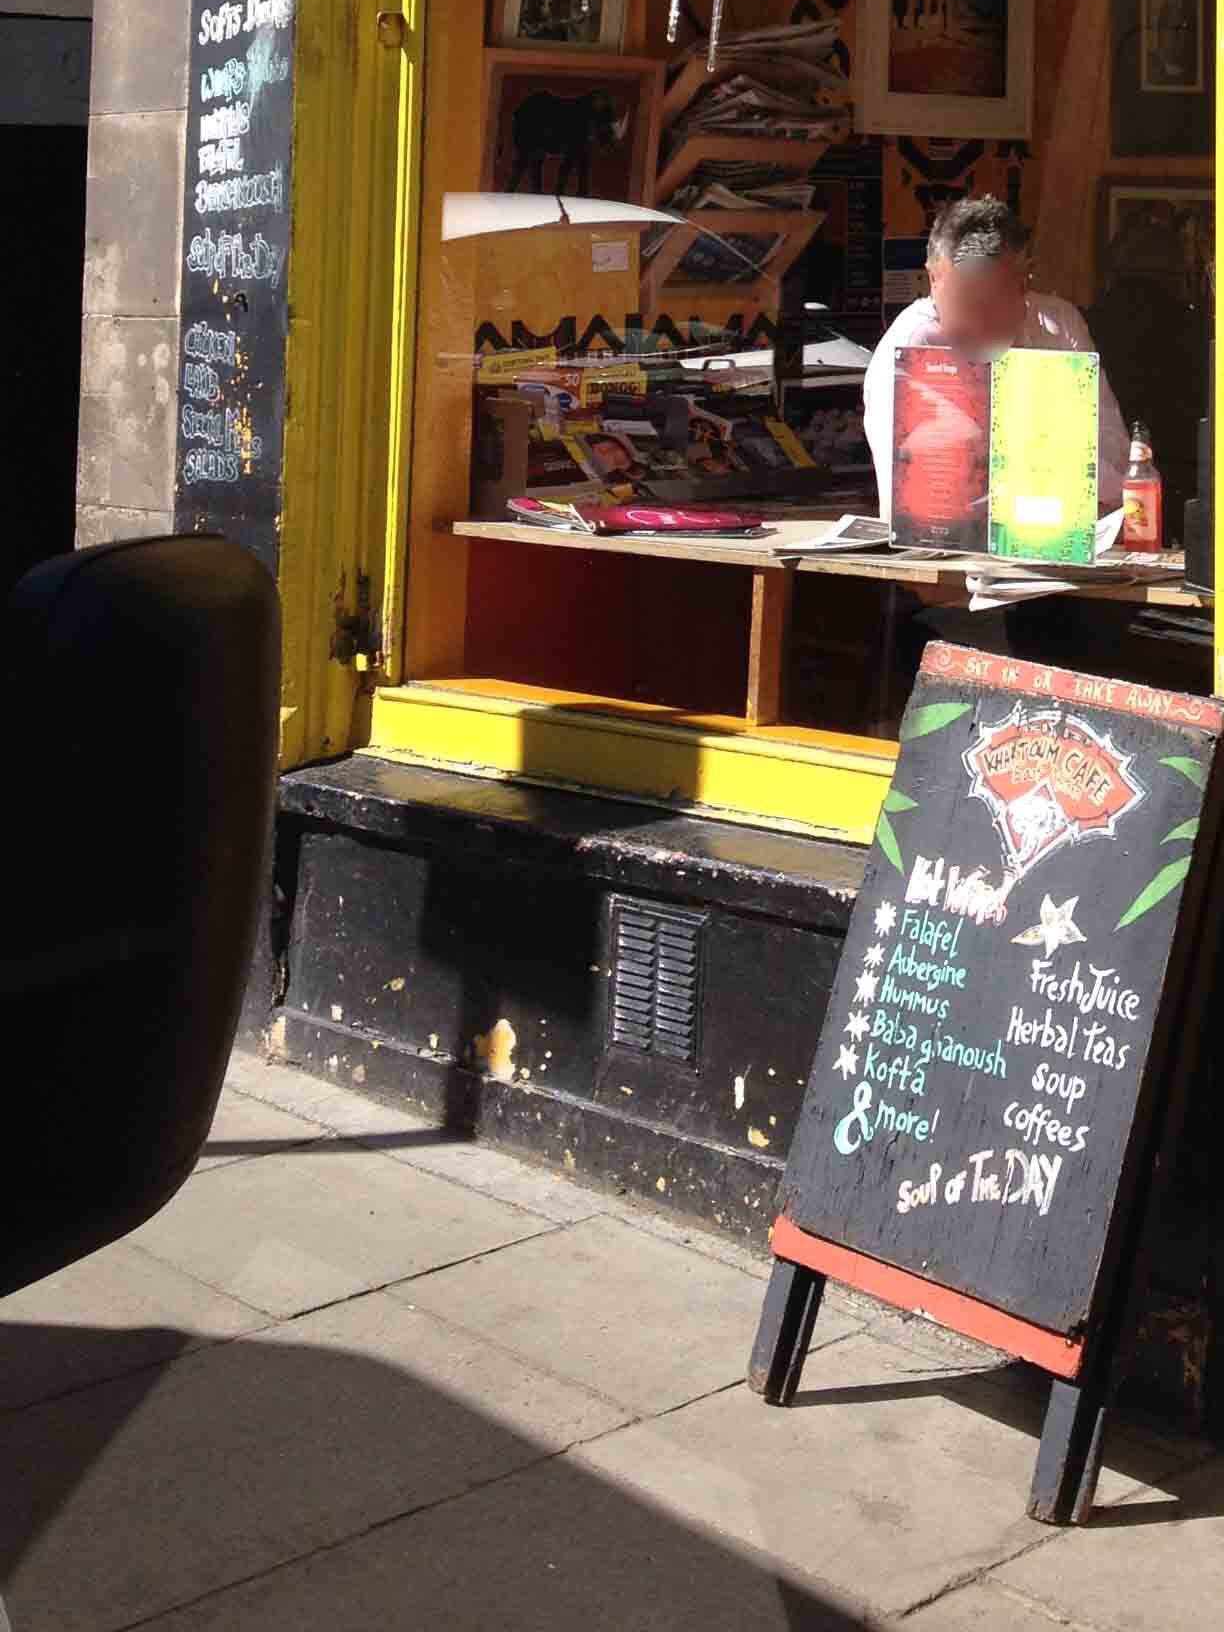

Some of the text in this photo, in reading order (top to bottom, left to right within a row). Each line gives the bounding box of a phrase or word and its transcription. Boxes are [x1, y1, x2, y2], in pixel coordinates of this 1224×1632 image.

[183, 448, 239, 485] SALADS
[1074, 678, 1115, 704] TAKE
[1127, 688, 1174, 713] AWAY
[983, 738, 1060, 773] KHARTOUM
[1064, 750, 1114, 805] CAFE
[901, 909, 963, 959] Falafel
[888, 944, 967, 991] Aubergine
[1030, 959, 1141, 1021] Fresh Juice
[870, 1010, 917, 1052] Baba
[1006, 1006, 1078, 1059] Herbal
[864, 1043, 926, 1096] Kofta
[874, 1100, 941, 1144] more!
[1001, 1149, 1063, 1216] DAY
